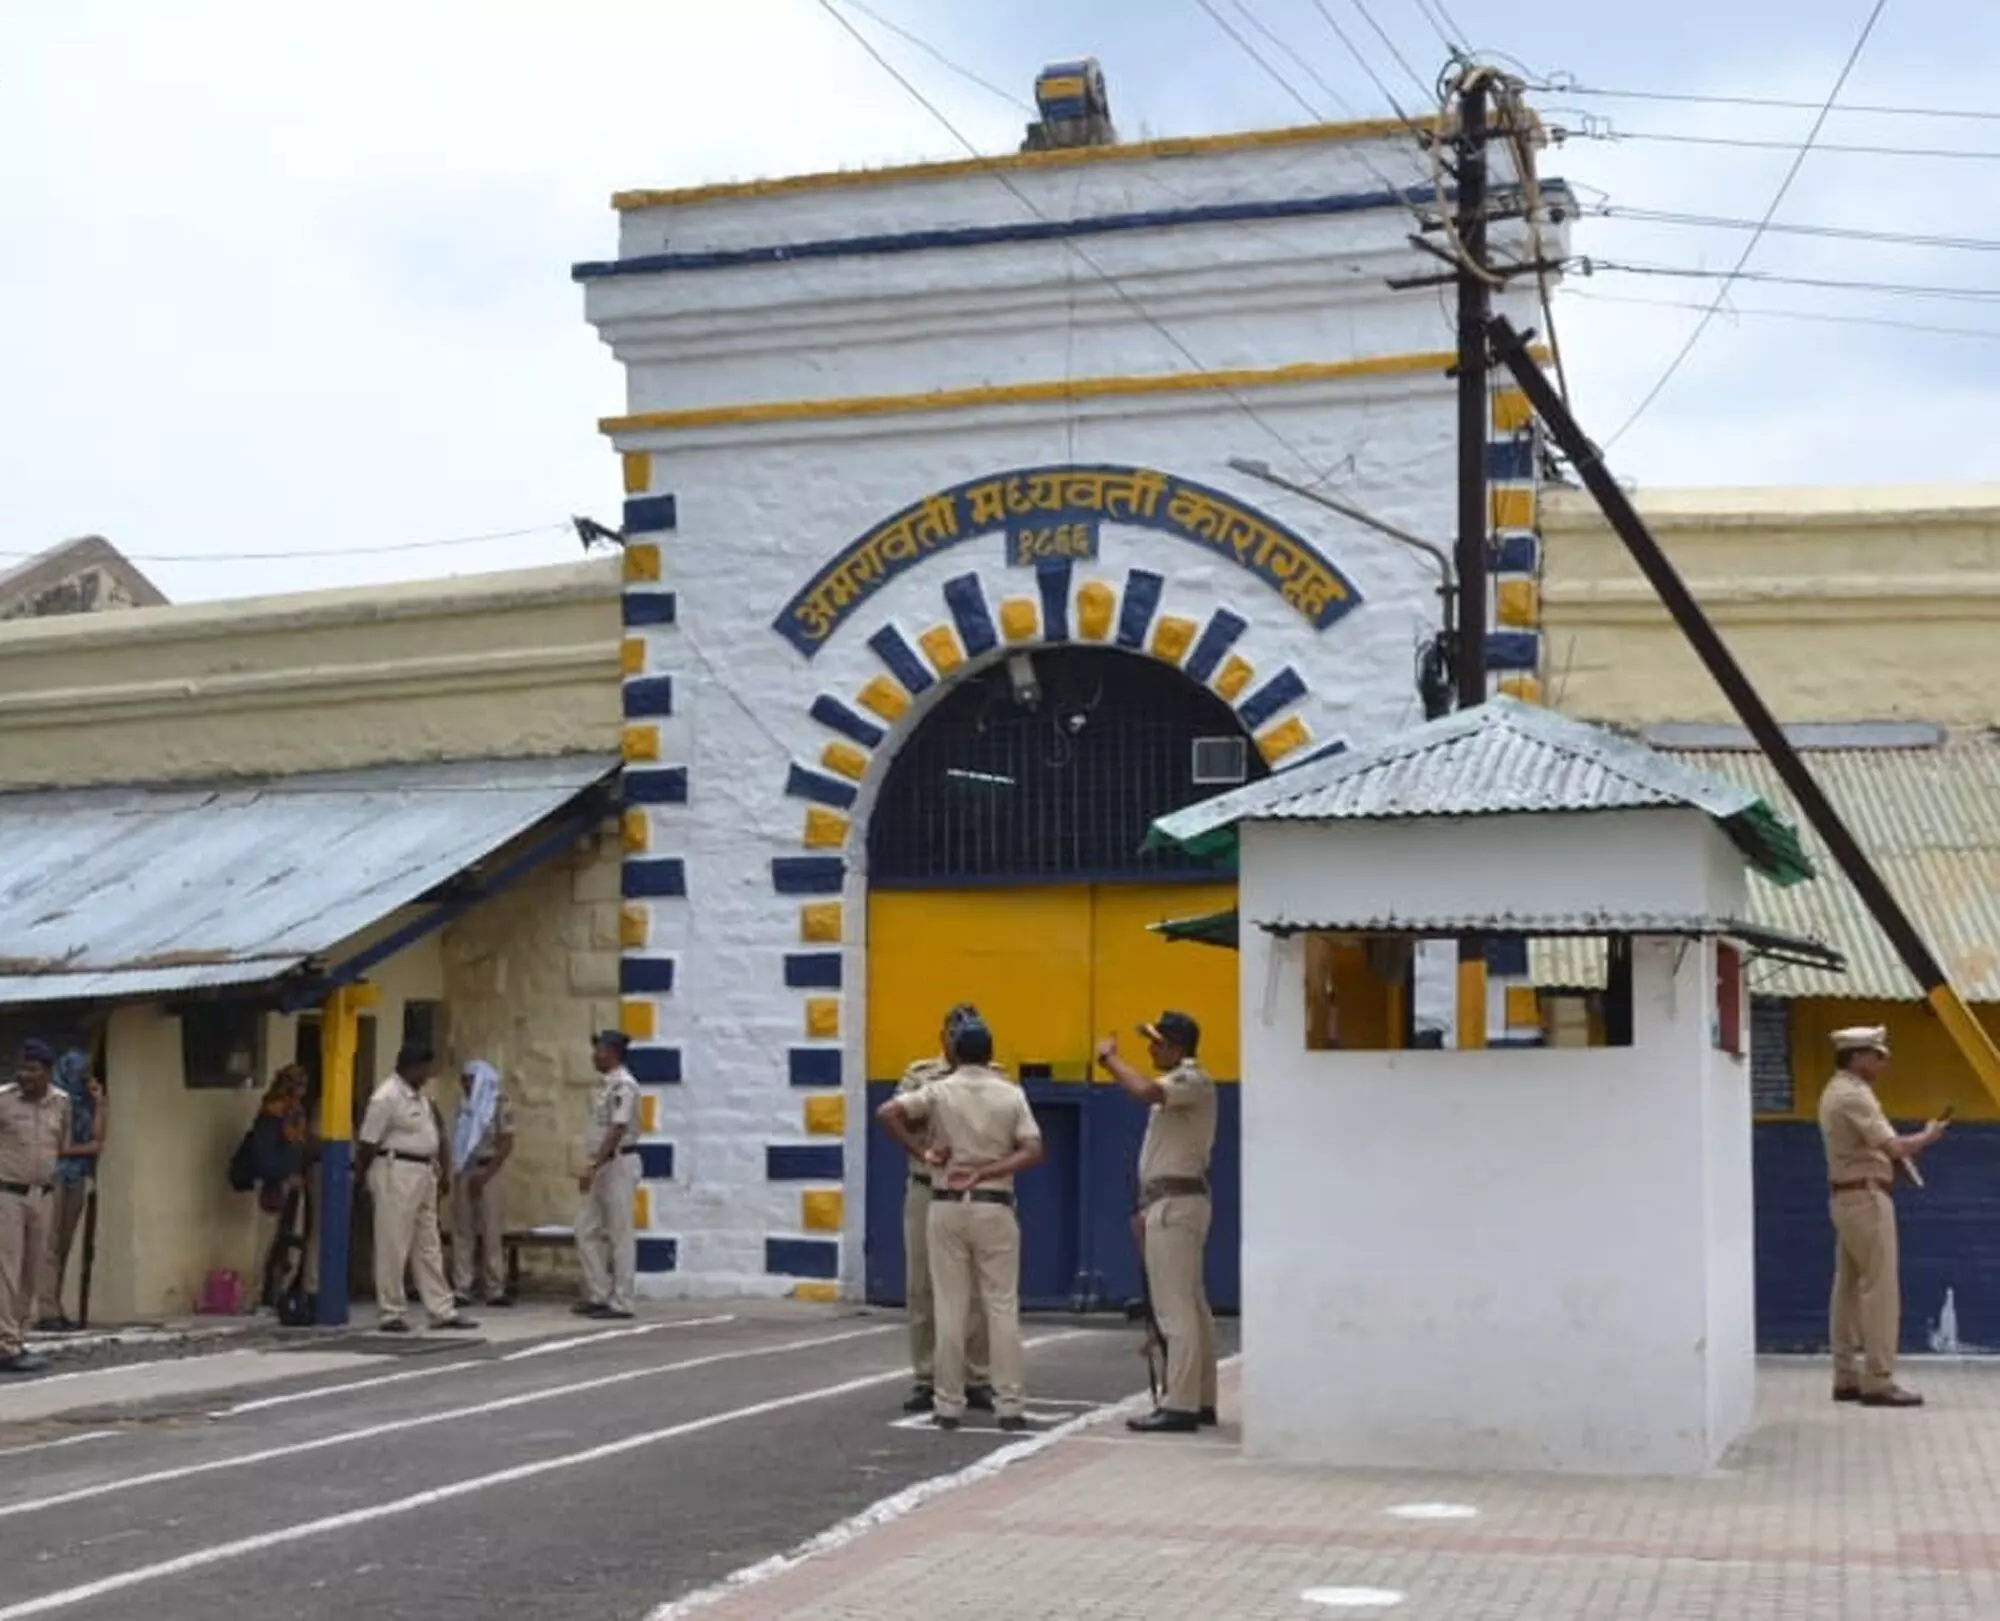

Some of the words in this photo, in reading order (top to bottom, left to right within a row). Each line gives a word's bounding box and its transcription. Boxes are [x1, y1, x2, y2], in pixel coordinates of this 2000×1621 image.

[794, 494, 958, 638] अमरावती
[966, 467, 1168, 525] मध्यवर्ती
[1167, 489, 1347, 617] कारागृह
